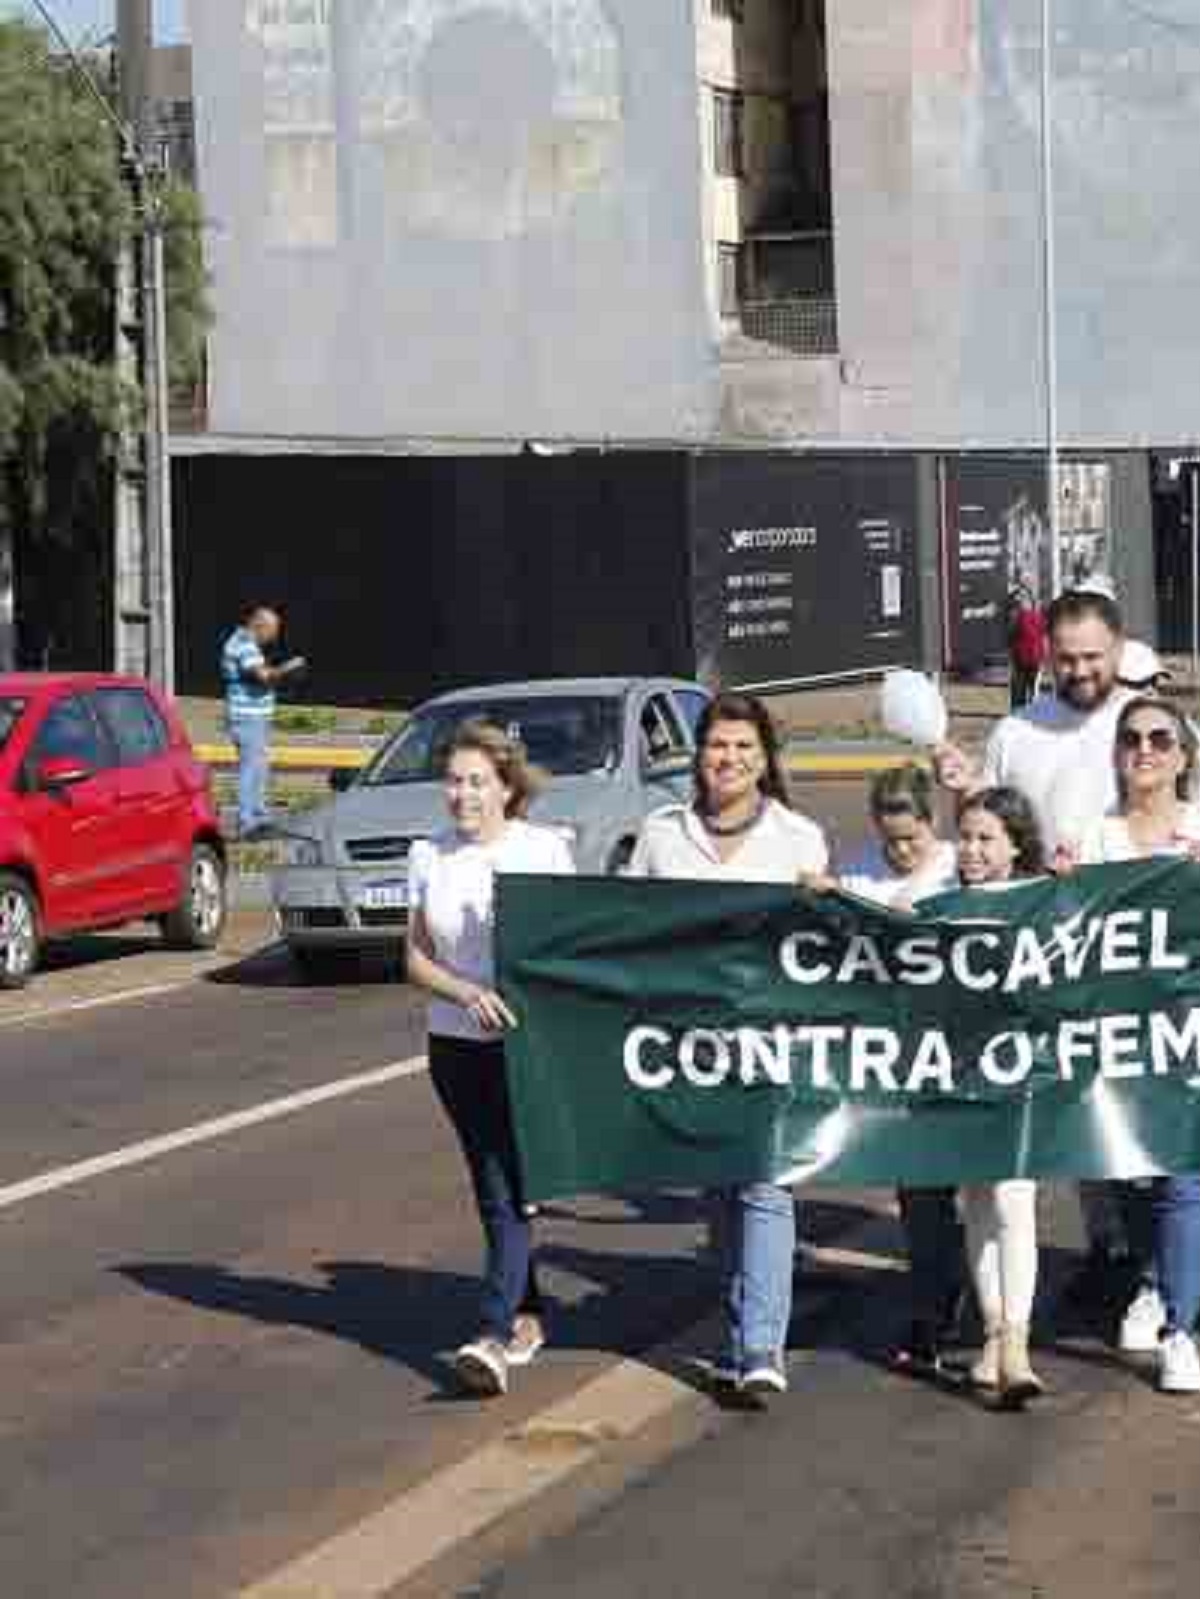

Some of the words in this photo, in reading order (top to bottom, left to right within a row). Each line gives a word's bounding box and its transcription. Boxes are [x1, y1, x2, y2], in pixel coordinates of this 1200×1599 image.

[779, 907, 1189, 992] CASCAVEL
[623, 1024, 956, 1091] CONTRA
[979, 1030, 1034, 1085] O
